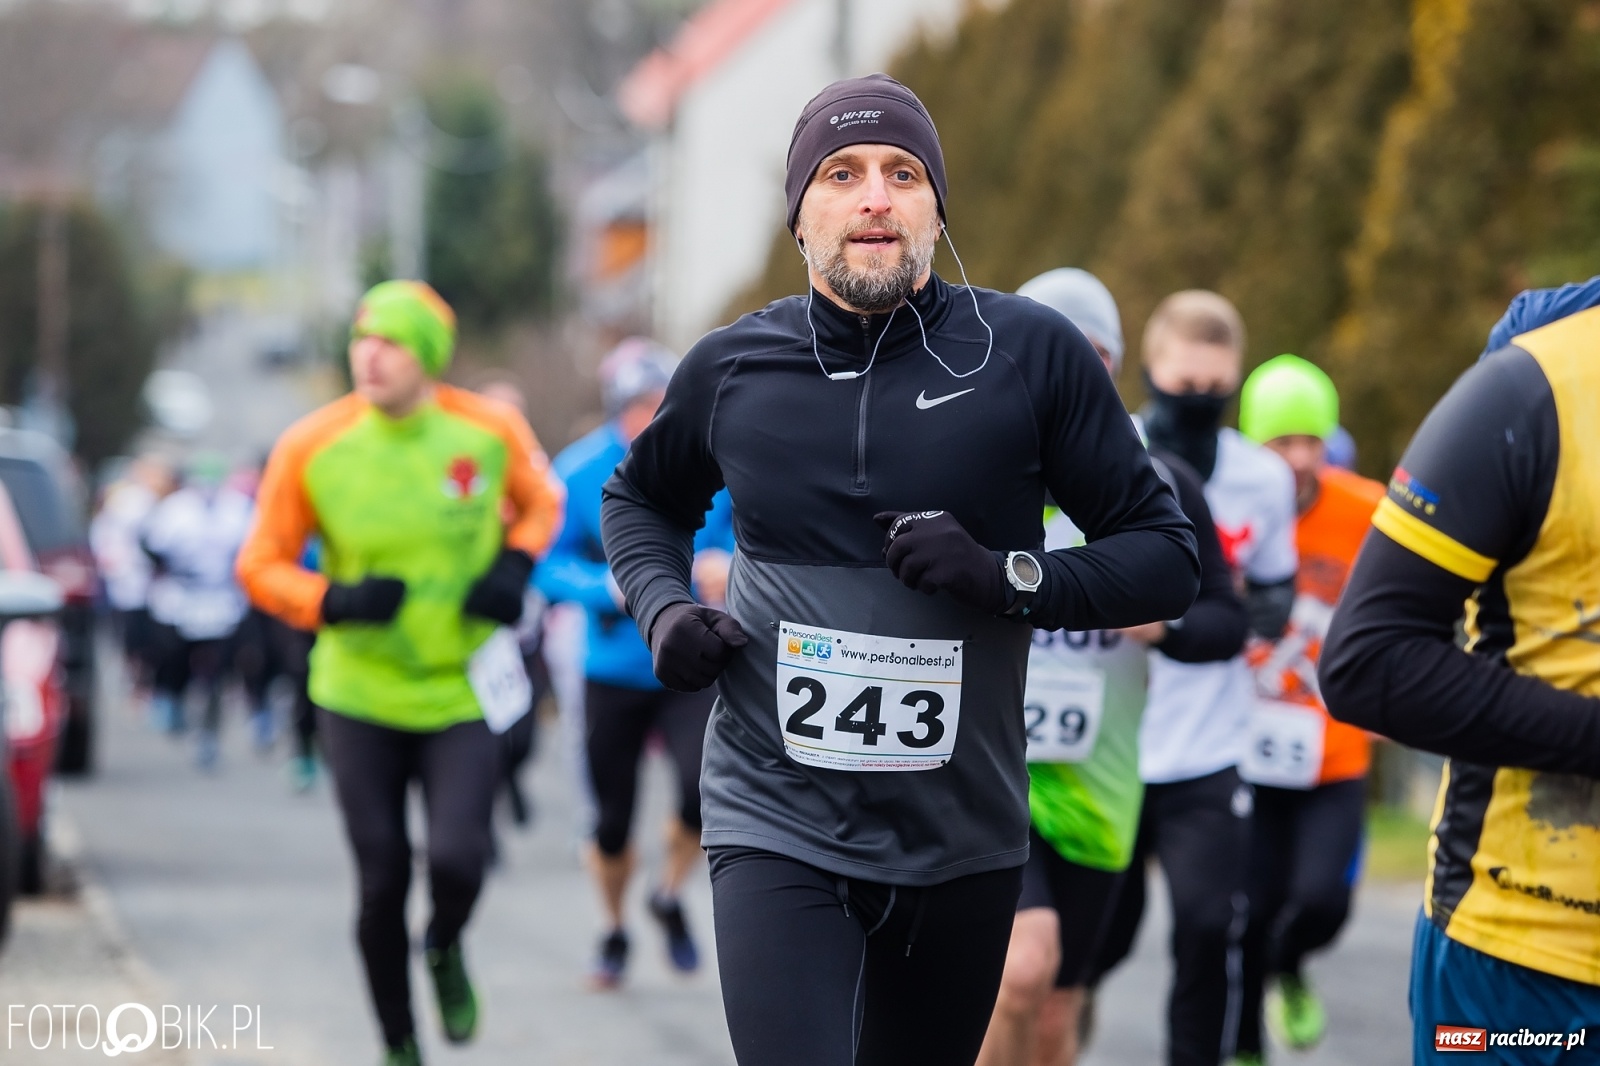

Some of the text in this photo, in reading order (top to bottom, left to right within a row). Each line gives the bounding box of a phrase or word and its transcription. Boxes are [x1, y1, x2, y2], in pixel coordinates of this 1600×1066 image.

[840, 110, 882, 120] HI-TEC
[788, 628, 832, 642] PersonalBest
[841, 649, 955, 668] www.personalbest.pl
[785, 676, 945, 748] 243
